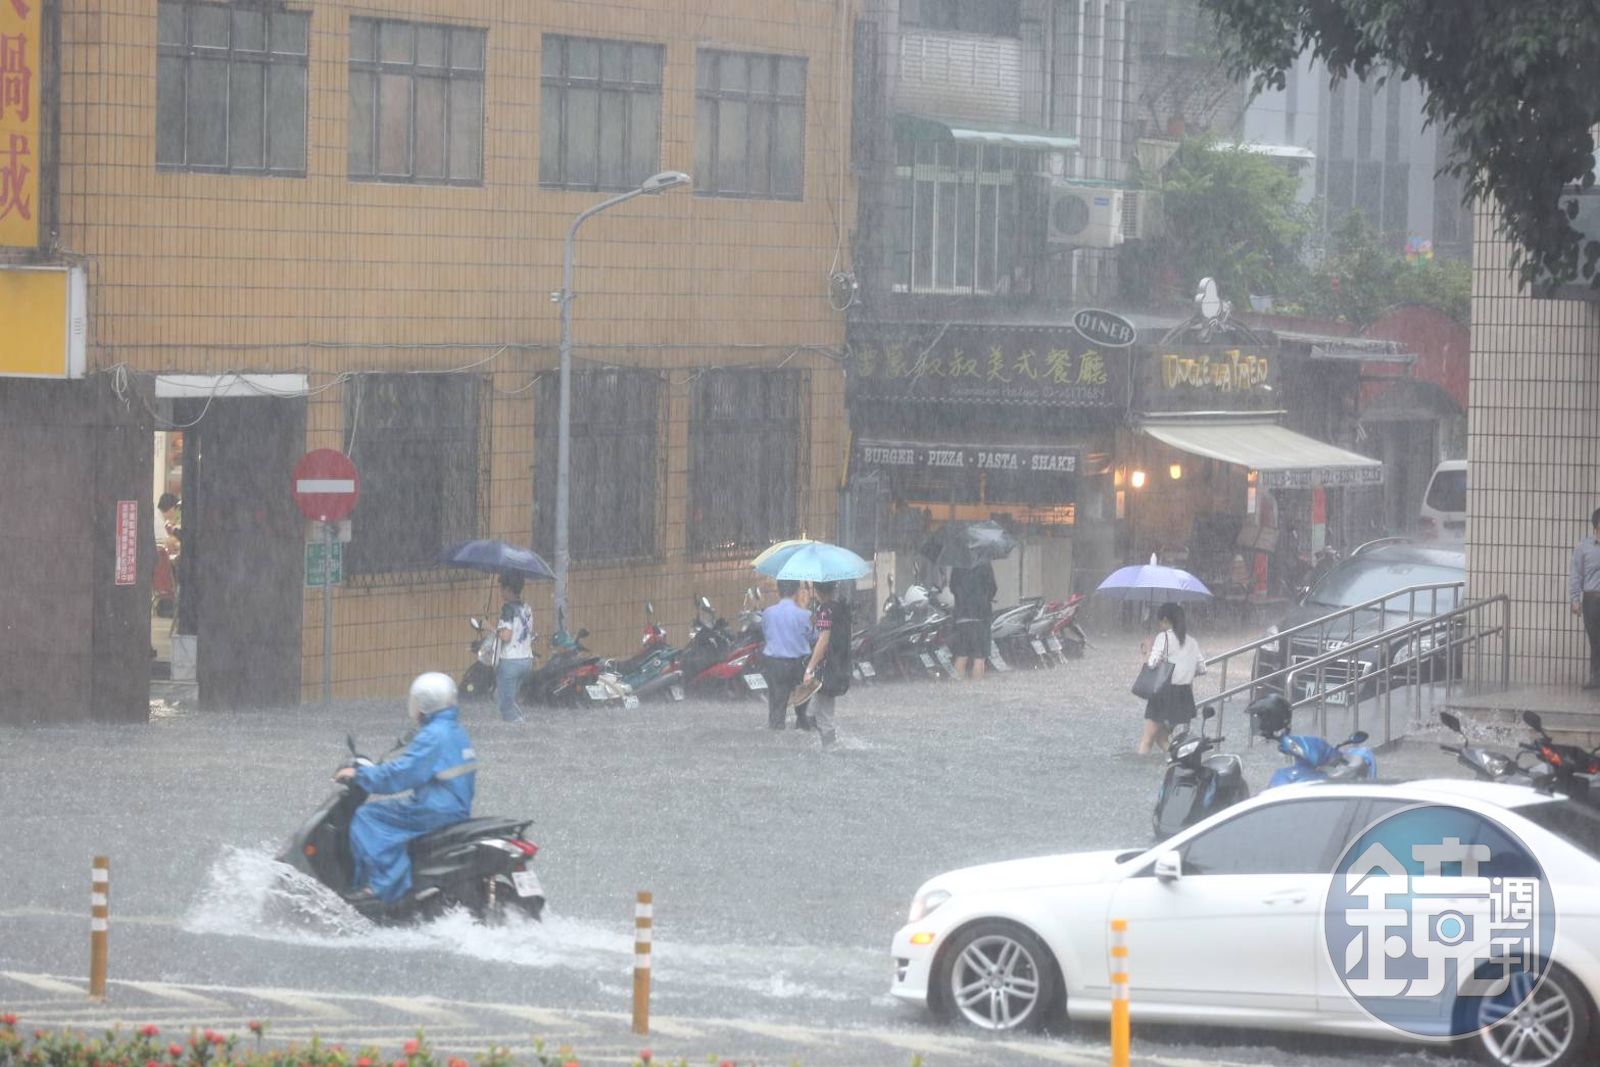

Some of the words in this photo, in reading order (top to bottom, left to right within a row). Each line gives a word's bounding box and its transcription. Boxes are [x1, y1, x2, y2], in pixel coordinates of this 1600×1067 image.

[1078, 312, 1131, 342] DINER
[863, 447, 915, 465] BURGER
[927, 449, 965, 468] PIZZA
[977, 452, 1019, 470] PASTA
[1030, 454, 1077, 472] SHAKE
